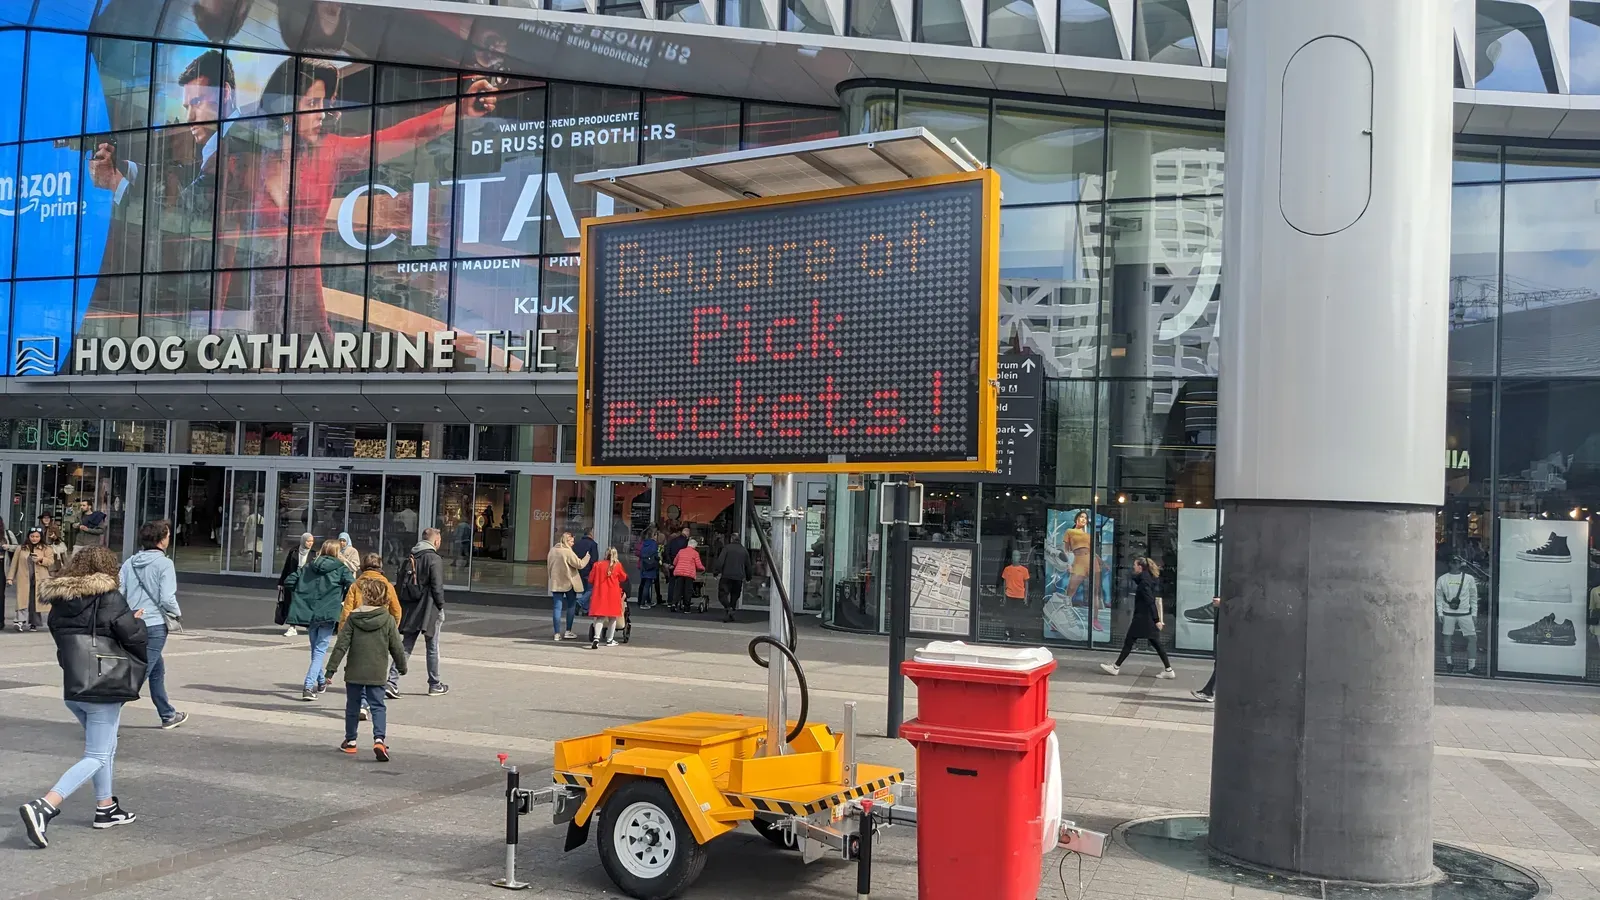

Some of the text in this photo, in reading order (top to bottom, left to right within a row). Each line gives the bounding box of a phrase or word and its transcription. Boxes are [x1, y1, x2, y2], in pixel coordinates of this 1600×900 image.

[500, 124, 517, 133] VAN
[579, 112, 639, 126] PRODUCENTE
[471, 139, 494, 155] DE
[0, 171, 71, 201] mazon
[463, 258, 520, 270] MADDEN
[549, 256, 581, 267] PRIY
[617, 210, 936, 298] Beware of
[514, 295, 575, 314] KIJK
[692, 299, 844, 365] Pick
[76, 336, 186, 371] HOOG
[197, 330, 457, 371] CATHARIJNE
[475, 329, 559, 368] THE
